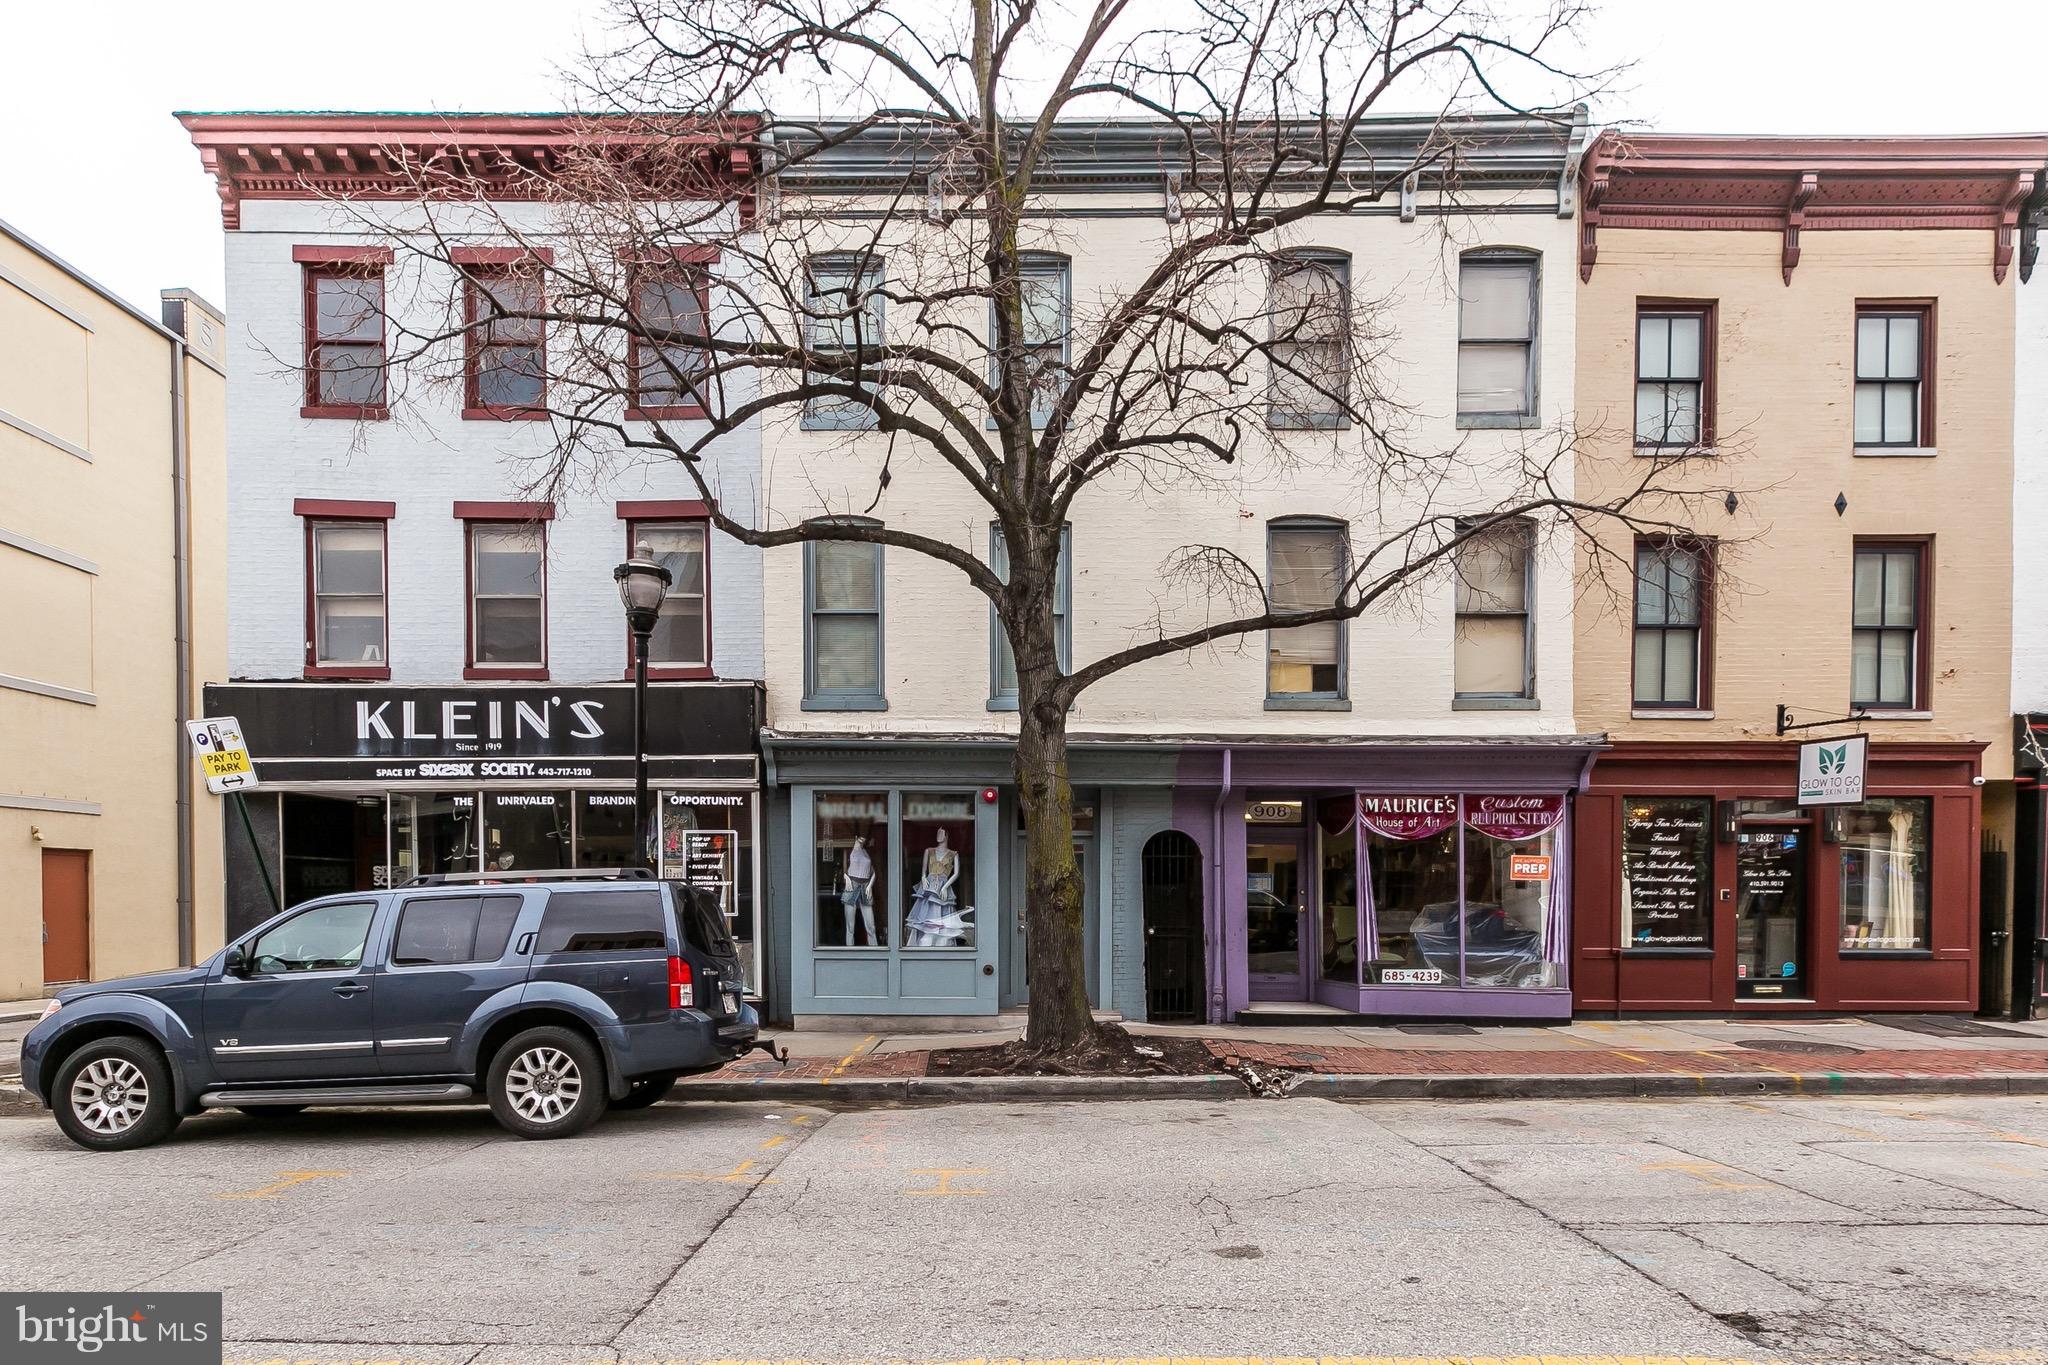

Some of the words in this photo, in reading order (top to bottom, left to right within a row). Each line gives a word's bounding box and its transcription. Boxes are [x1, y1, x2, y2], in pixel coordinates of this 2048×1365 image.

[356, 696, 605, 739] KLEIN'S
[455, 742, 479, 751] Since
[485, 742, 502, 751] 1919
[207, 754, 225, 764] PAY
[227, 752, 241, 761] TO
[214, 763, 241, 773] PARK
[376, 769, 403, 777] SPACE
[404, 769, 416, 777] BY
[480, 762, 535, 776] SOCIETY.
[538, 768, 592, 776] 443-717-1210
[1801, 779, 1828, 789] GLOW
[1830, 777, 1842, 787] TO
[1845, 775, 1861, 786] GO
[1846, 787, 1860, 795] BAR
[453, 797, 473, 806] THE
[497, 796, 555, 805] UNRIVALED
[589, 796, 636, 805] BRANDIN
[670, 796, 744, 805] OPPORTUNITY.
[1365, 795, 1456, 813] MAURICE'S
[1480, 796, 1544, 812] Custom
[1254, 806, 1287, 817] 908
[1376, 816, 1404, 827] House
[1408, 817, 1418, 827] of
[1423, 816, 1440, 827] Art
[1471, 812, 1551, 824] REUPHOLSTERY
[1628, 818, 1653, 829] Spray
[1654, 818, 1670, 827] Tan
[1671, 818, 1703, 828] Services
[1651, 833, 1680, 841] Facials
[1756, 834, 1774, 842] 906
[1649, 847, 1681, 858] Waxings
[1514, 863, 1547, 873] PREP
[1633, 861, 1646, 869] Air
[1646, 861, 1668, 869] Brush
[1668, 861, 1696, 872] Makeup
[1632, 873, 1670, 882] Traditional
[1670, 875, 1697, 885] Makeup
[1632, 887, 1659, 897] Organic
[1659, 887, 1677, 895] Skin
[1679, 887, 1696, 895] Care
[1659, 901, 1676, 909] Skin
[1678, 901, 1695, 909] Care
[1648, 911, 1679, 919] Products
[1384, 971, 1440, 981] 685-4239
